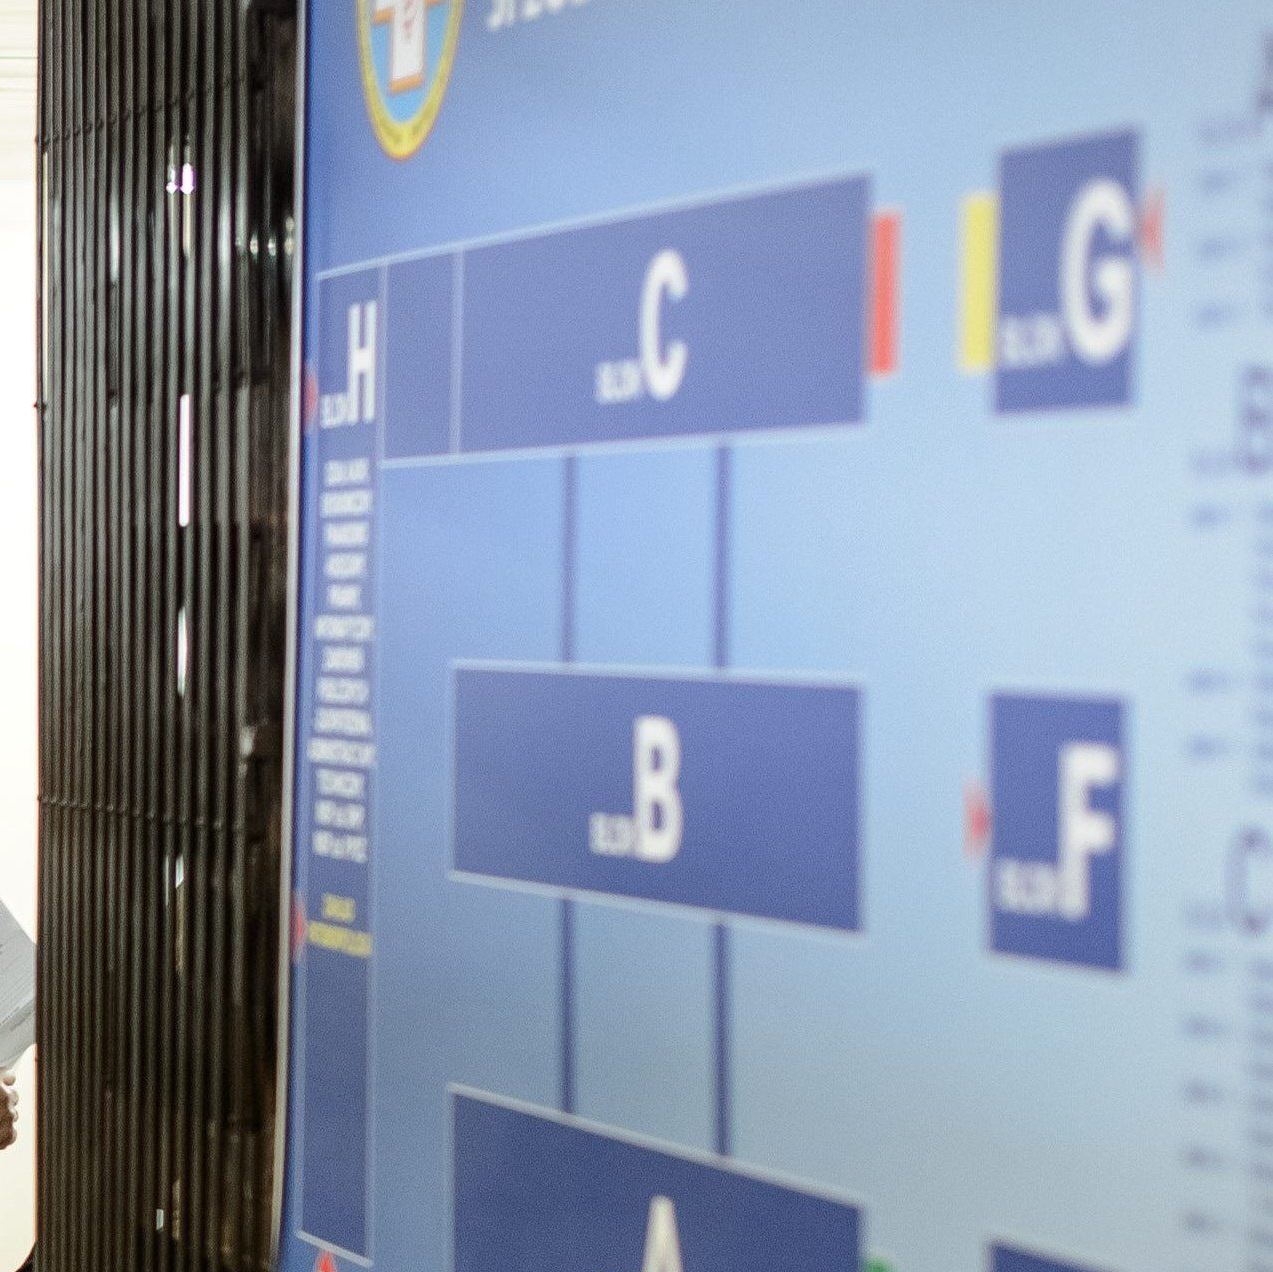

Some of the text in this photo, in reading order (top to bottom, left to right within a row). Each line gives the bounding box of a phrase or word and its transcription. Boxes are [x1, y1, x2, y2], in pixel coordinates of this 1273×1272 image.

[641, 250, 690, 400] C
[1064, 180, 1136, 363] G
[348, 301, 376, 424] H
[634, 715, 682, 863] B
[1057, 742, 1119, 919] F
